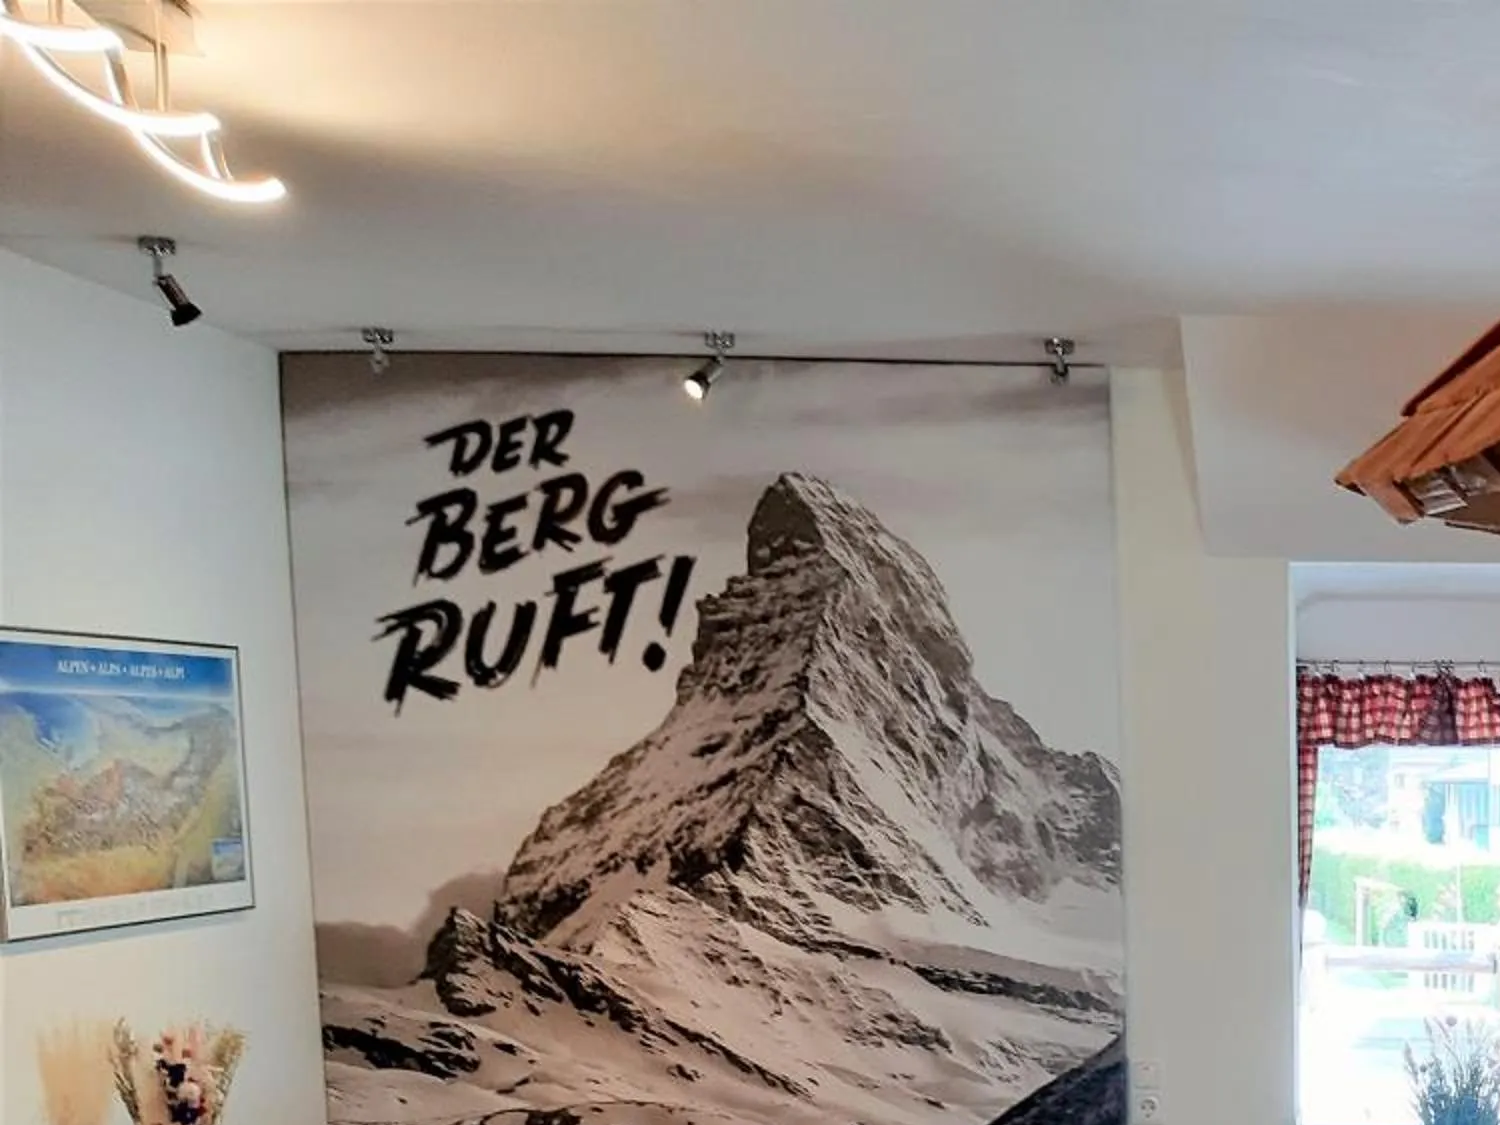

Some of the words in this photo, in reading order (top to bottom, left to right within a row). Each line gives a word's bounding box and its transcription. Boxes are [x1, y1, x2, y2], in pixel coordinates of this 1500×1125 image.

[423, 409, 574, 476] DER
[405, 470, 671, 587] BERG
[371, 554, 697, 717] RUFT!
